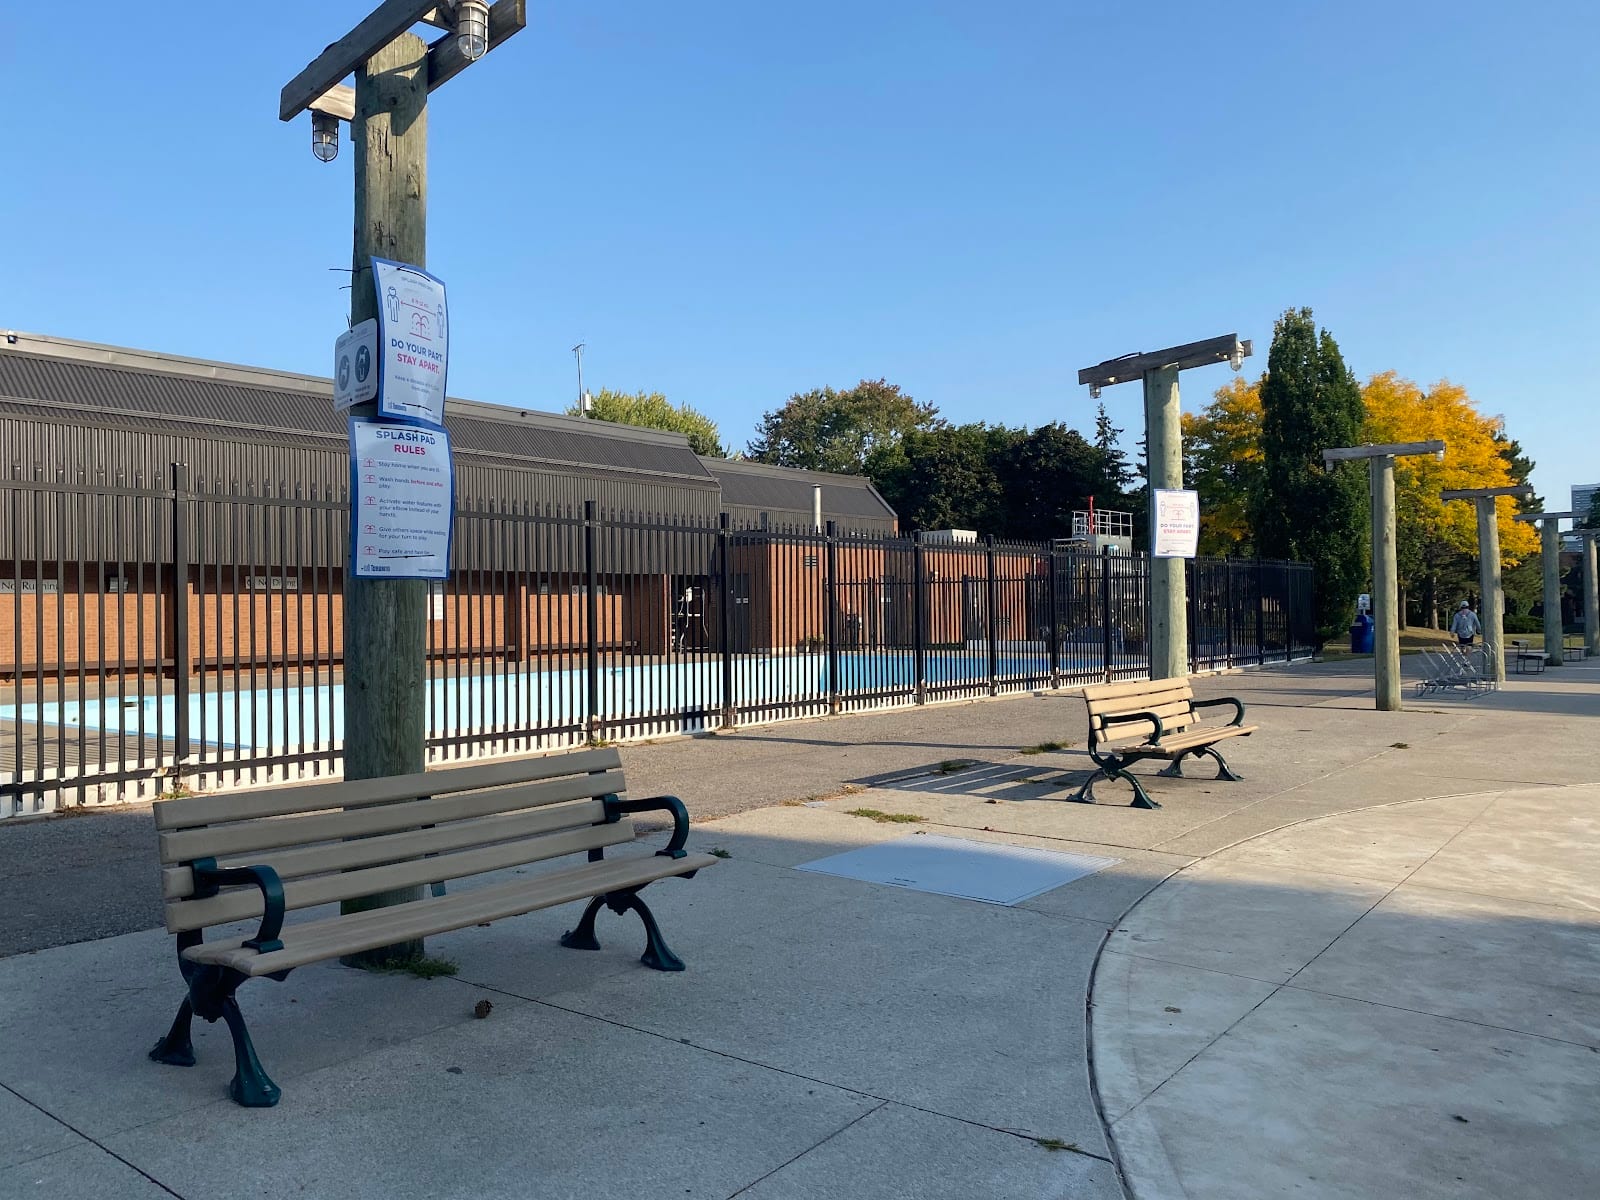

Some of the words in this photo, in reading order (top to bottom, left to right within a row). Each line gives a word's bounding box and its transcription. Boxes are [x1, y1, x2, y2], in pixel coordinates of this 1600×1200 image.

[391, 338, 404, 349] DO
[406, 342, 427, 357] YOUR
[397, 353, 417, 366] STAY
[419, 359, 440, 374] APART.
[376, 430, 418, 442] SPLASH
[420, 434, 436, 445] PAD
[394, 444, 426, 456] RULES
